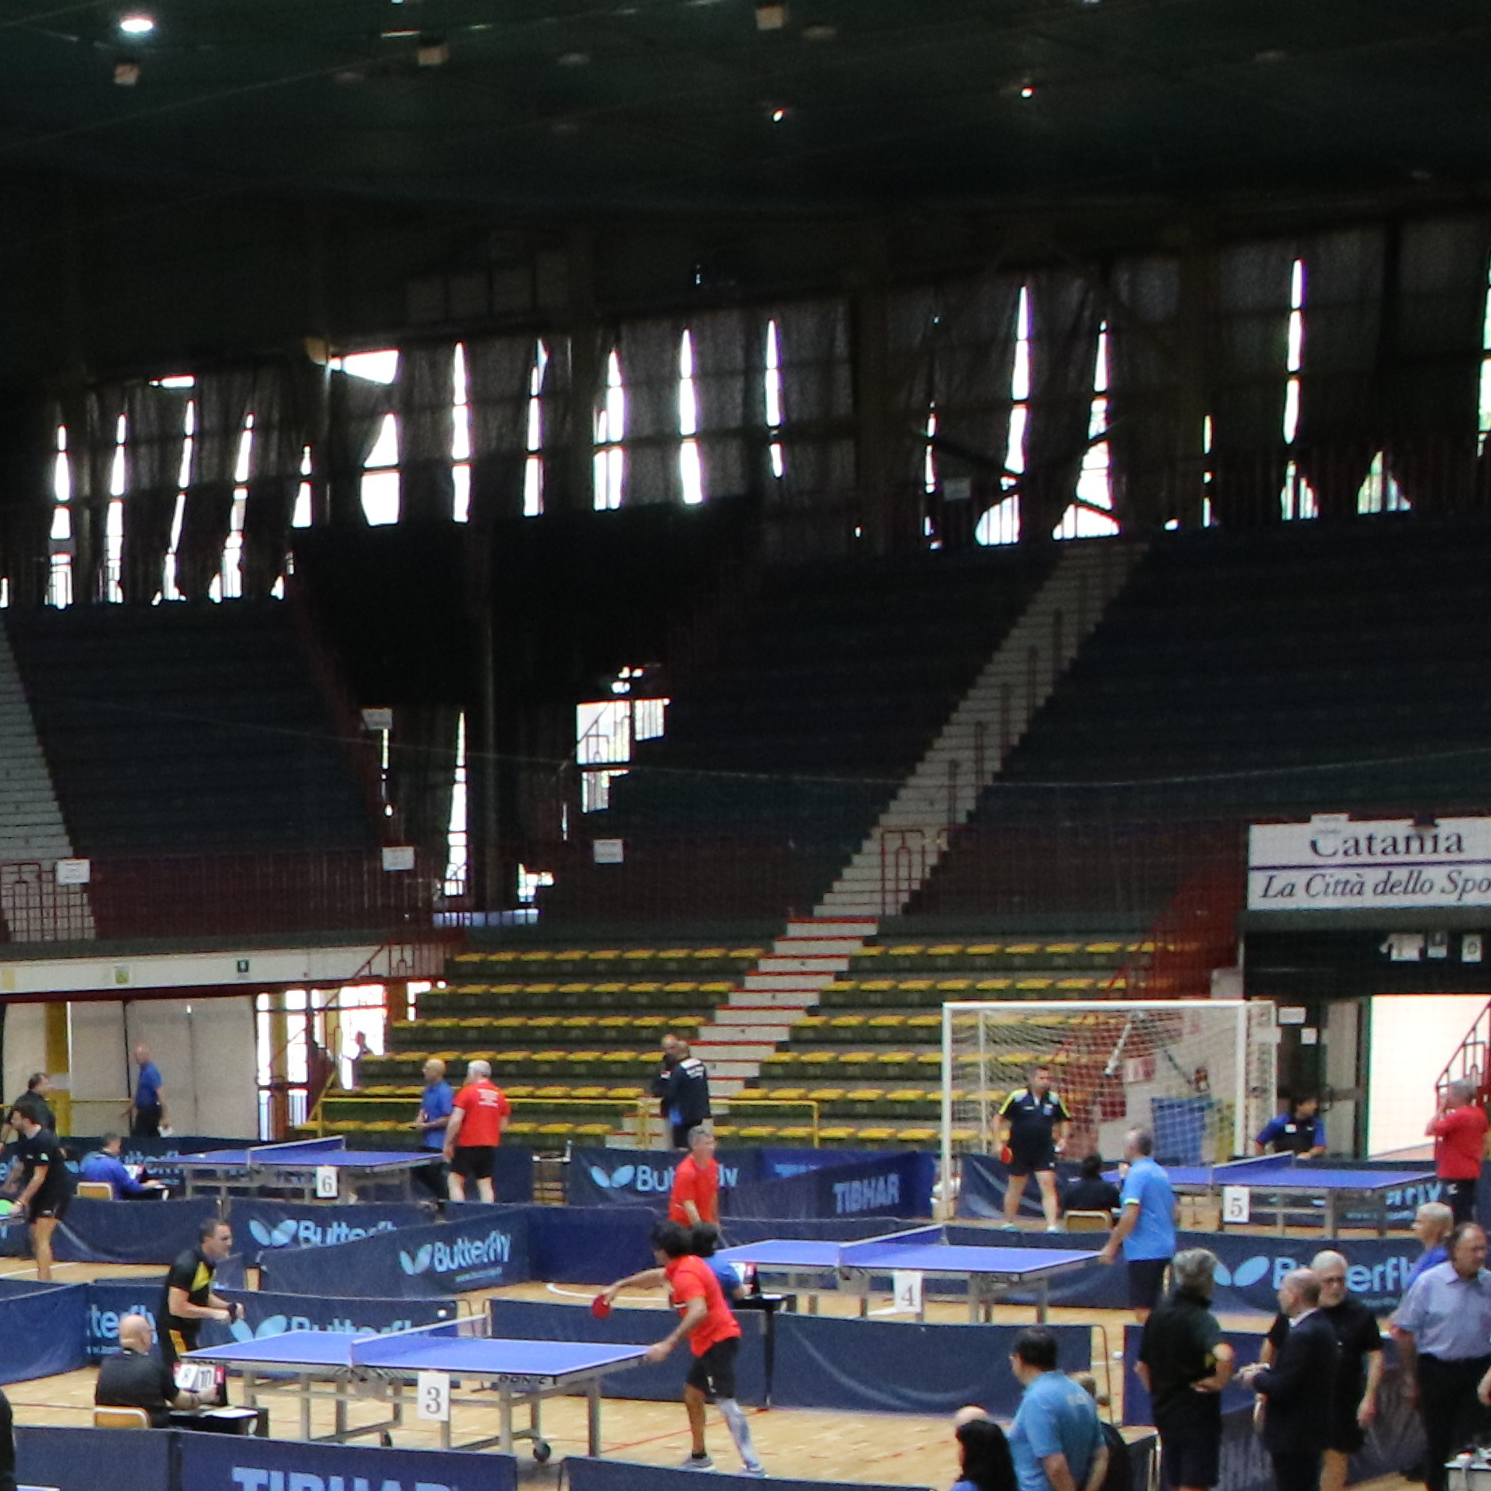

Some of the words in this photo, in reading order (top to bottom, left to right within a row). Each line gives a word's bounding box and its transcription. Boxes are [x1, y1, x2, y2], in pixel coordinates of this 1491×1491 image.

[1309, 828, 1466, 859] Catania
[1260, 875, 1296, 899] La
[1304, 872, 1367, 897] Città
[1374, 869, 1434, 897] dello
[322, 1174, 333, 1193] 6
[833, 1172, 901, 1215] TIBHAR
[1230, 1197, 1244, 1220] 5
[433, 1228, 512, 1273] Butterfly
[901, 1282, 916, 1308] 4
[425, 1385, 441, 1415] 3
